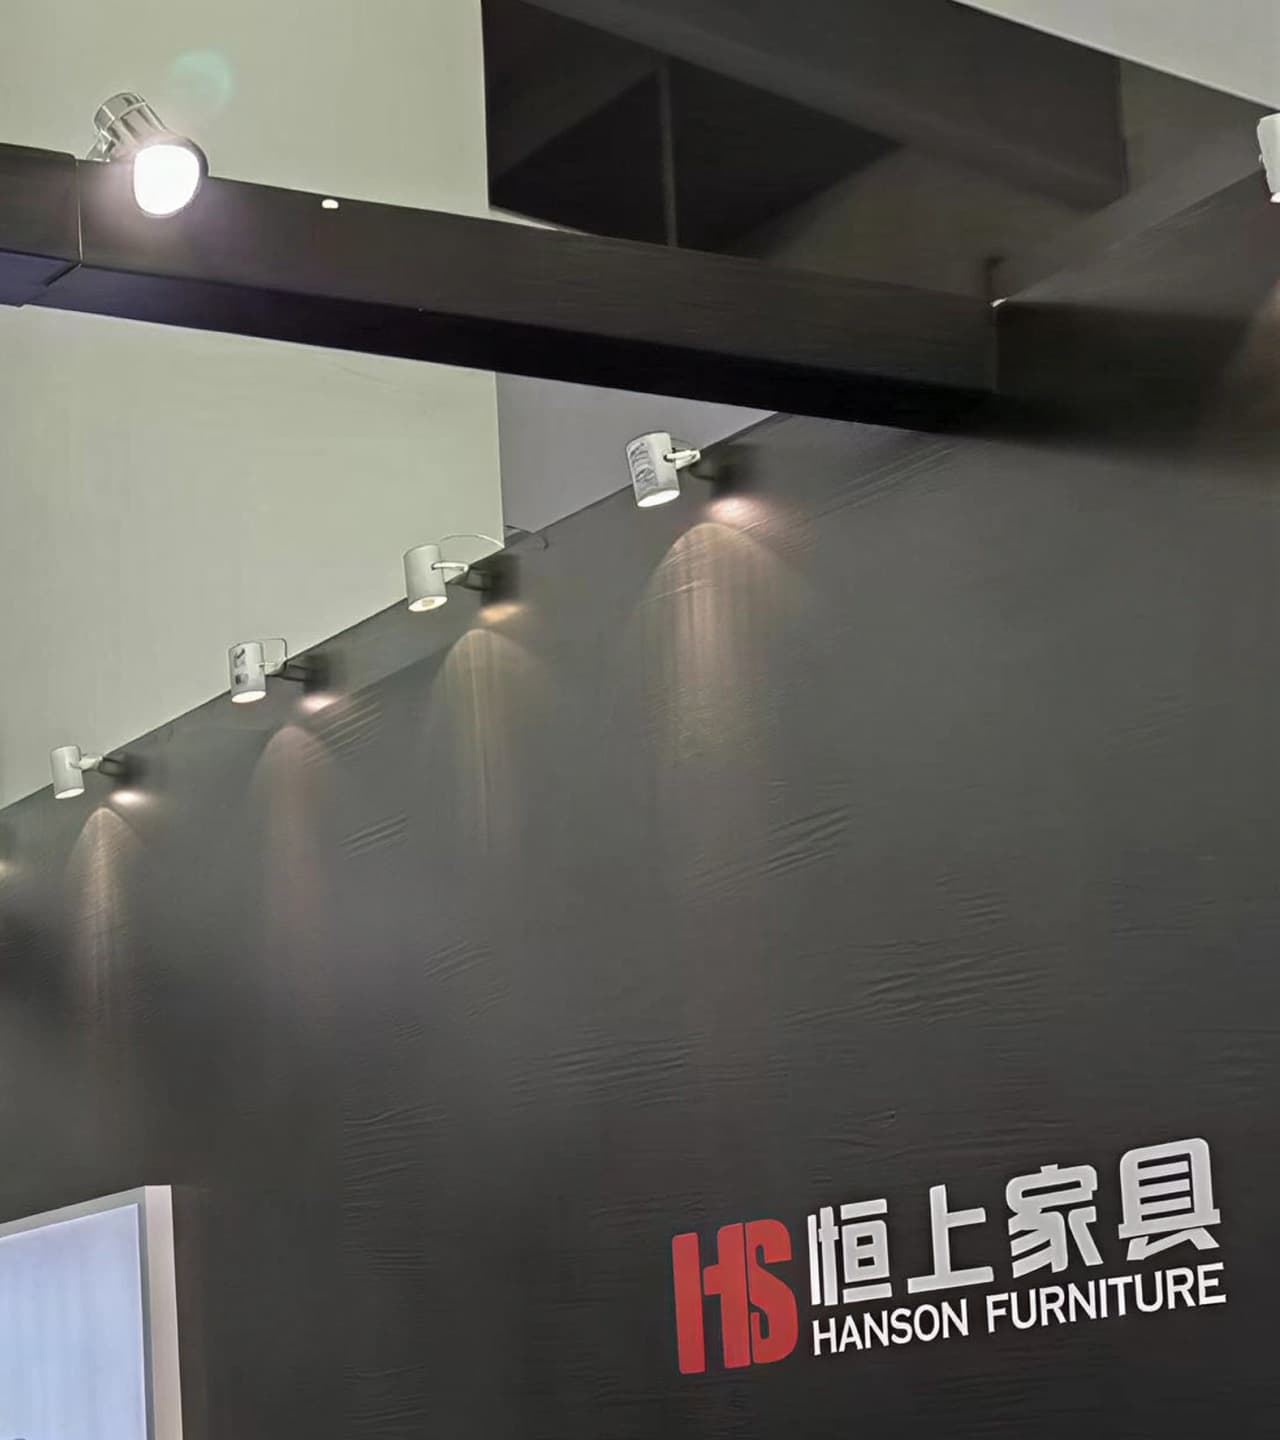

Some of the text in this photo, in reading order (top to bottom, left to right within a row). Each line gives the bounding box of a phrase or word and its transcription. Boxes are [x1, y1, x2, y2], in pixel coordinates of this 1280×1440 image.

[807, 1137, 1221, 1306] 恒上家具
[812, 1262, 1228, 1356] HANSON FURNITURE
